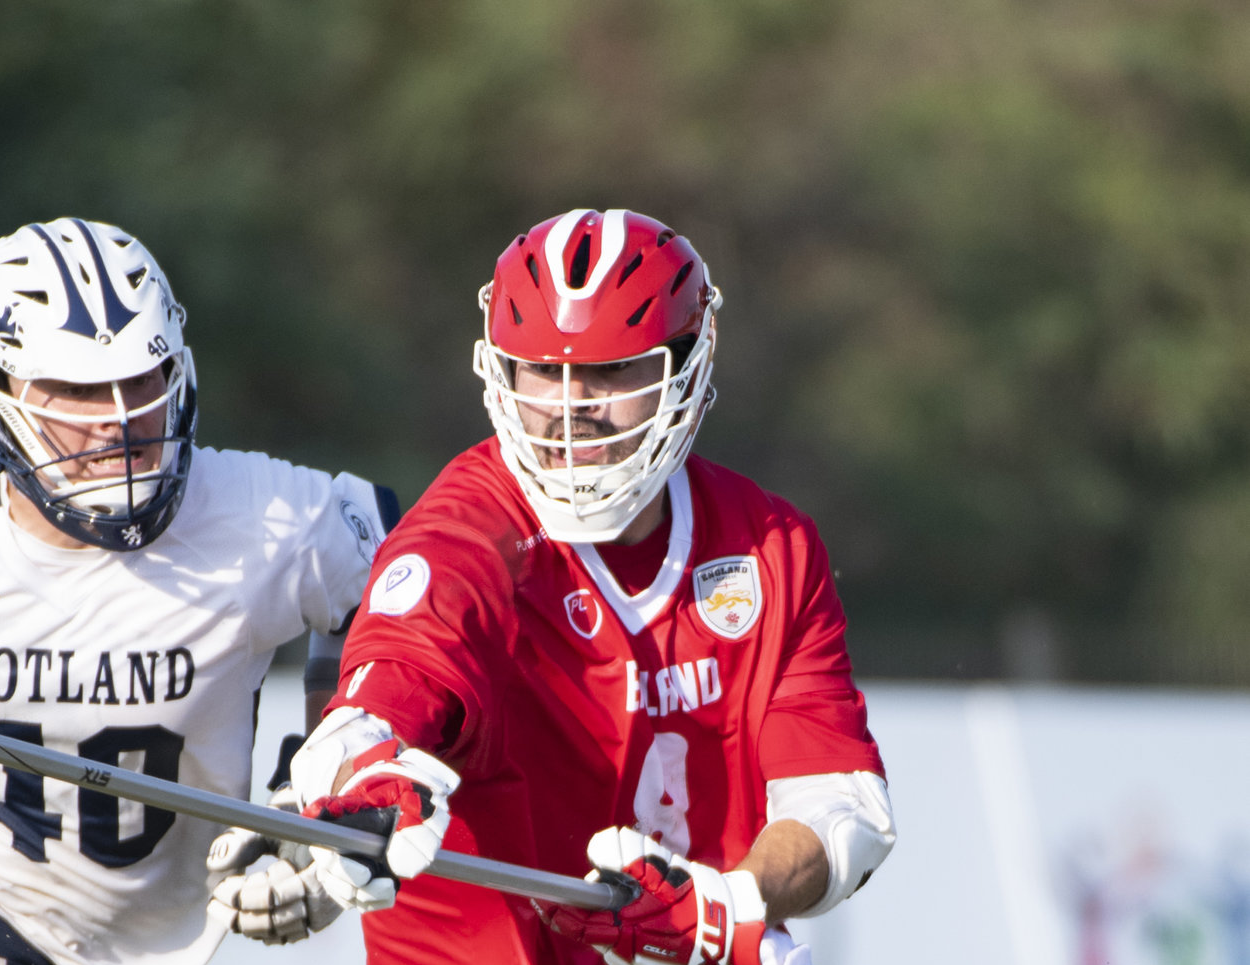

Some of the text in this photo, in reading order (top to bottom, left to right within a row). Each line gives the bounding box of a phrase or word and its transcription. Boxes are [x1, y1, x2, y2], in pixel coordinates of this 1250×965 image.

[147, 334, 169, 358] 40
[701, 566, 748, 582] ENGLAND
[80, 765, 111, 786] STX
